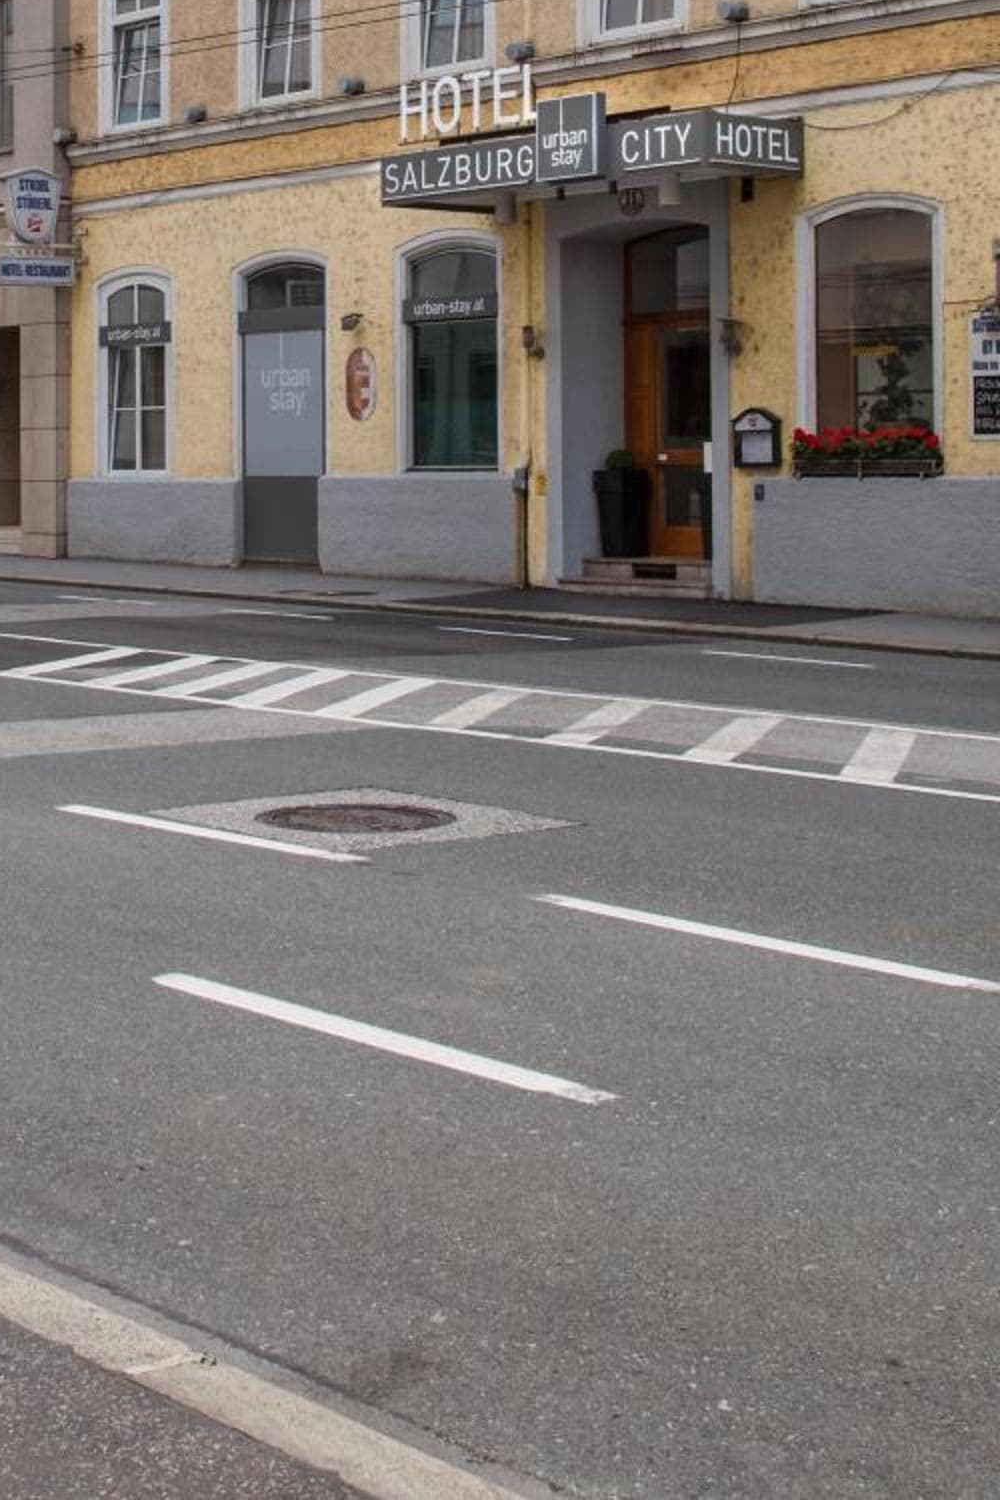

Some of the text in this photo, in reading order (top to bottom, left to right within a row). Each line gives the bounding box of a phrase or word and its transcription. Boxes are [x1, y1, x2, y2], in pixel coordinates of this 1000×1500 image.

[399, 65, 538, 142] HOTEL
[543, 127, 587, 149] urban
[621, 122, 798, 163] CITY HOTEL
[385, 146, 533, 193] SALZBURG
[551, 147, 583, 169] stay
[413, 297, 484, 316] urban-stay.at
[261, 365, 310, 387] urban
[270, 388, 306, 416] stay
